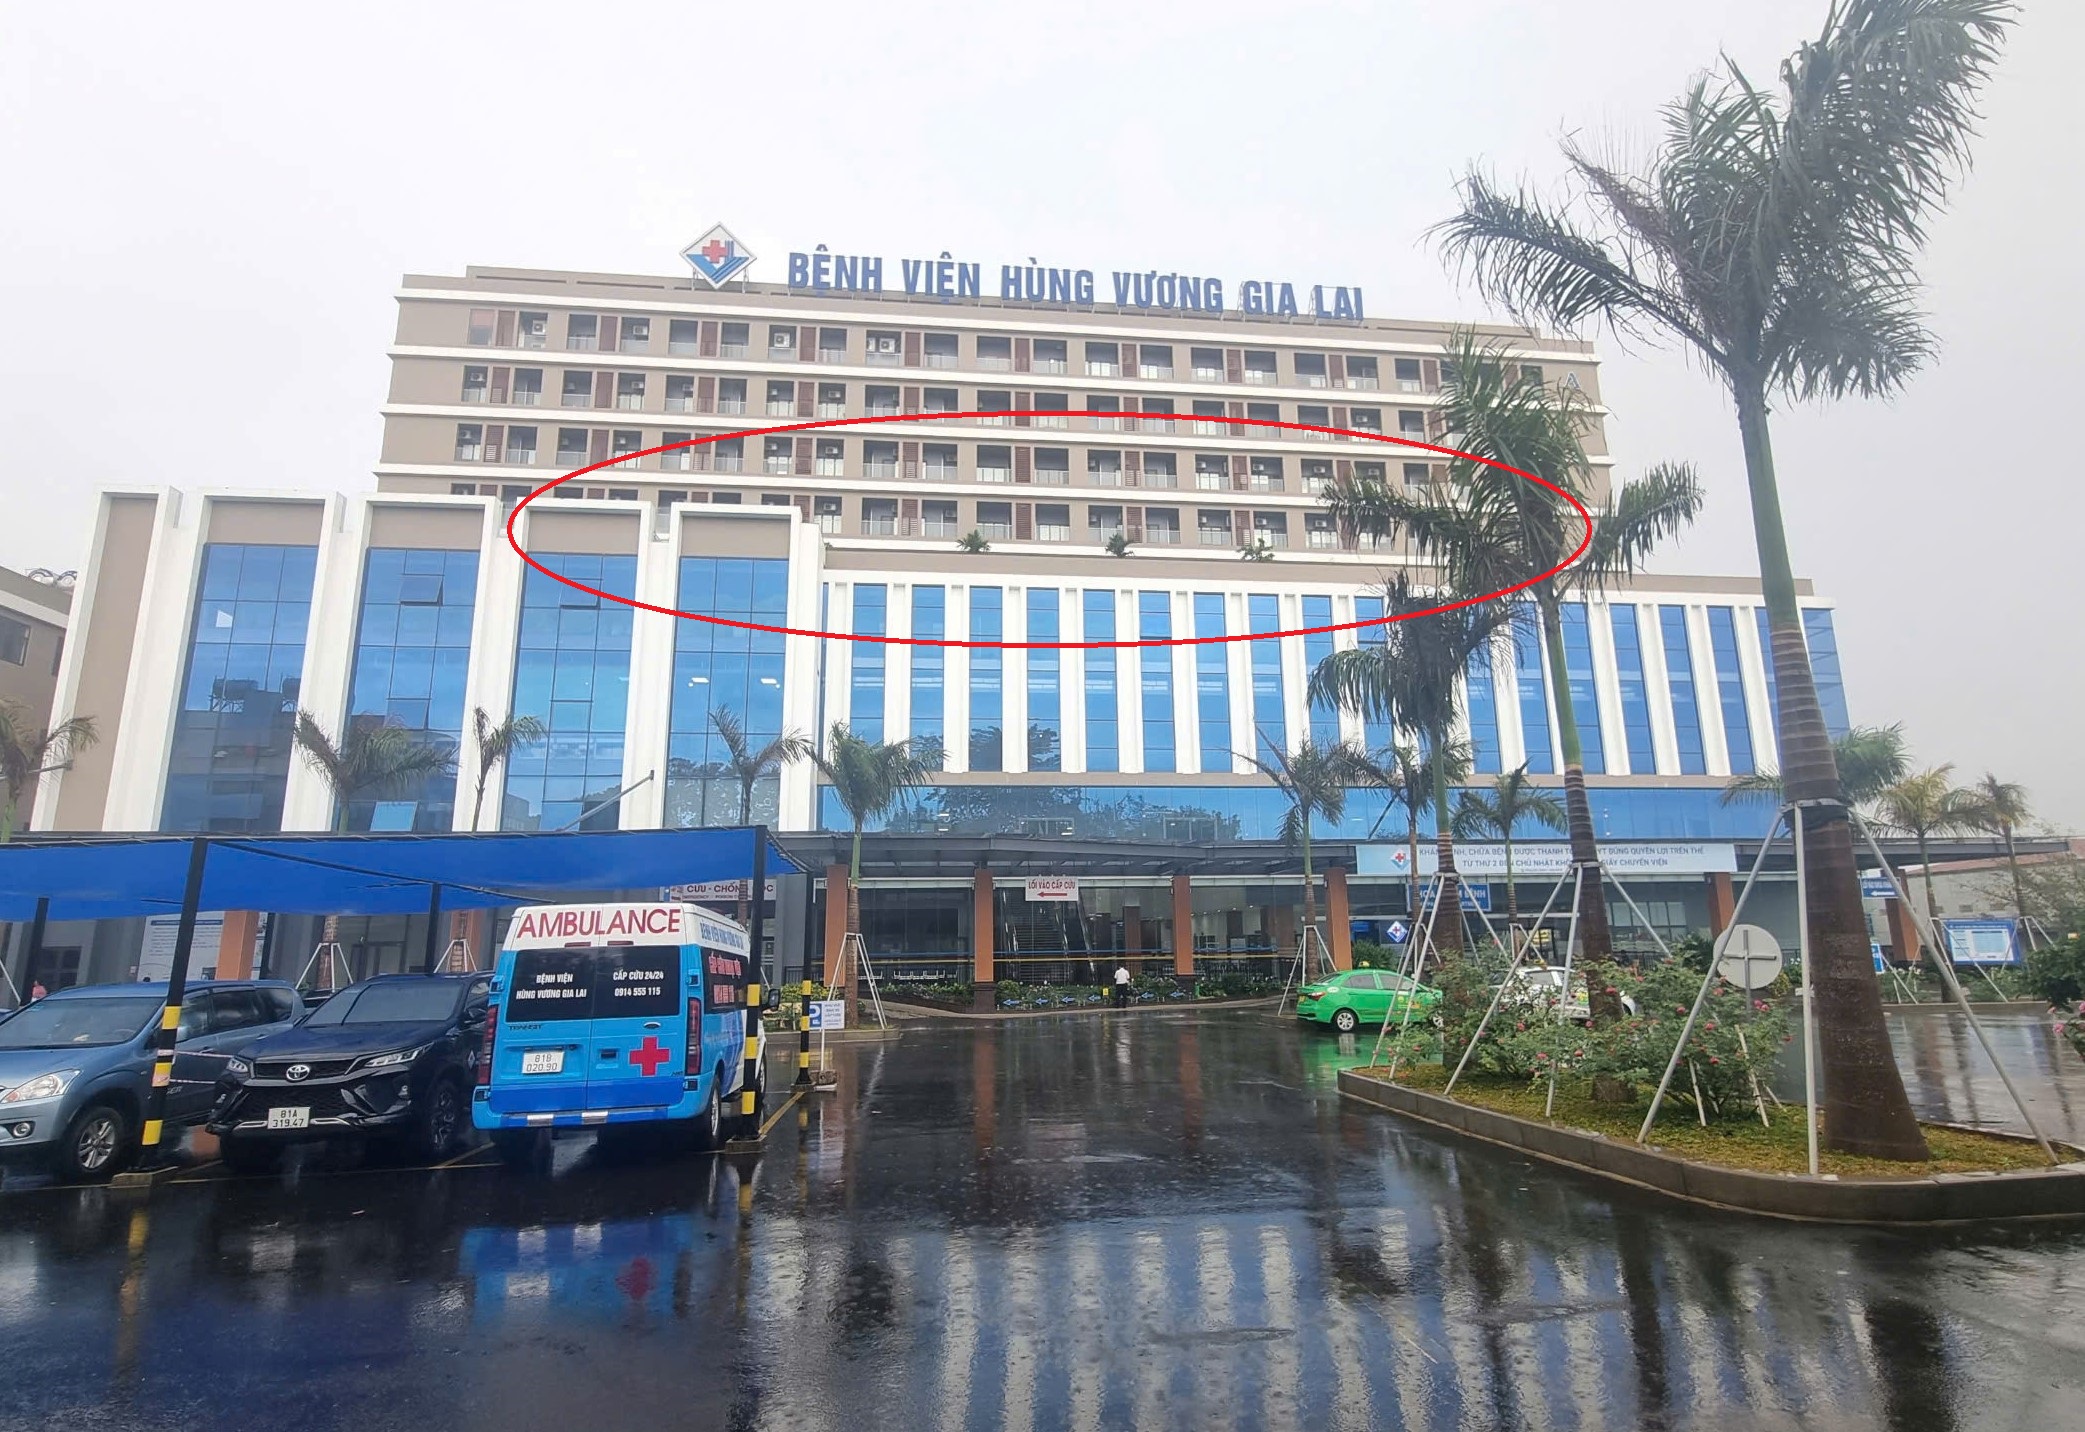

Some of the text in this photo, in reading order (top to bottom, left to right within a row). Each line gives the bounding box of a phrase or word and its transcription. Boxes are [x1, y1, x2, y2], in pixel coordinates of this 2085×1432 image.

[788, 243, 1365, 322] BỆNH VIỆN HÙNG VƯƠNG GIA LAI
[517, 908, 681, 939] AMBULANCE
[536, 972, 573, 985] BỆNH VIỆN
[613, 969, 628, 981] CẤP
[645, 970, 664, 980] 24/24
[516, 988, 587, 1000] HÙNG VƯƠNG GIA LAI
[614, 986, 661, 997] 0914 555 115
[280, 1109, 298, 1119] 81A
